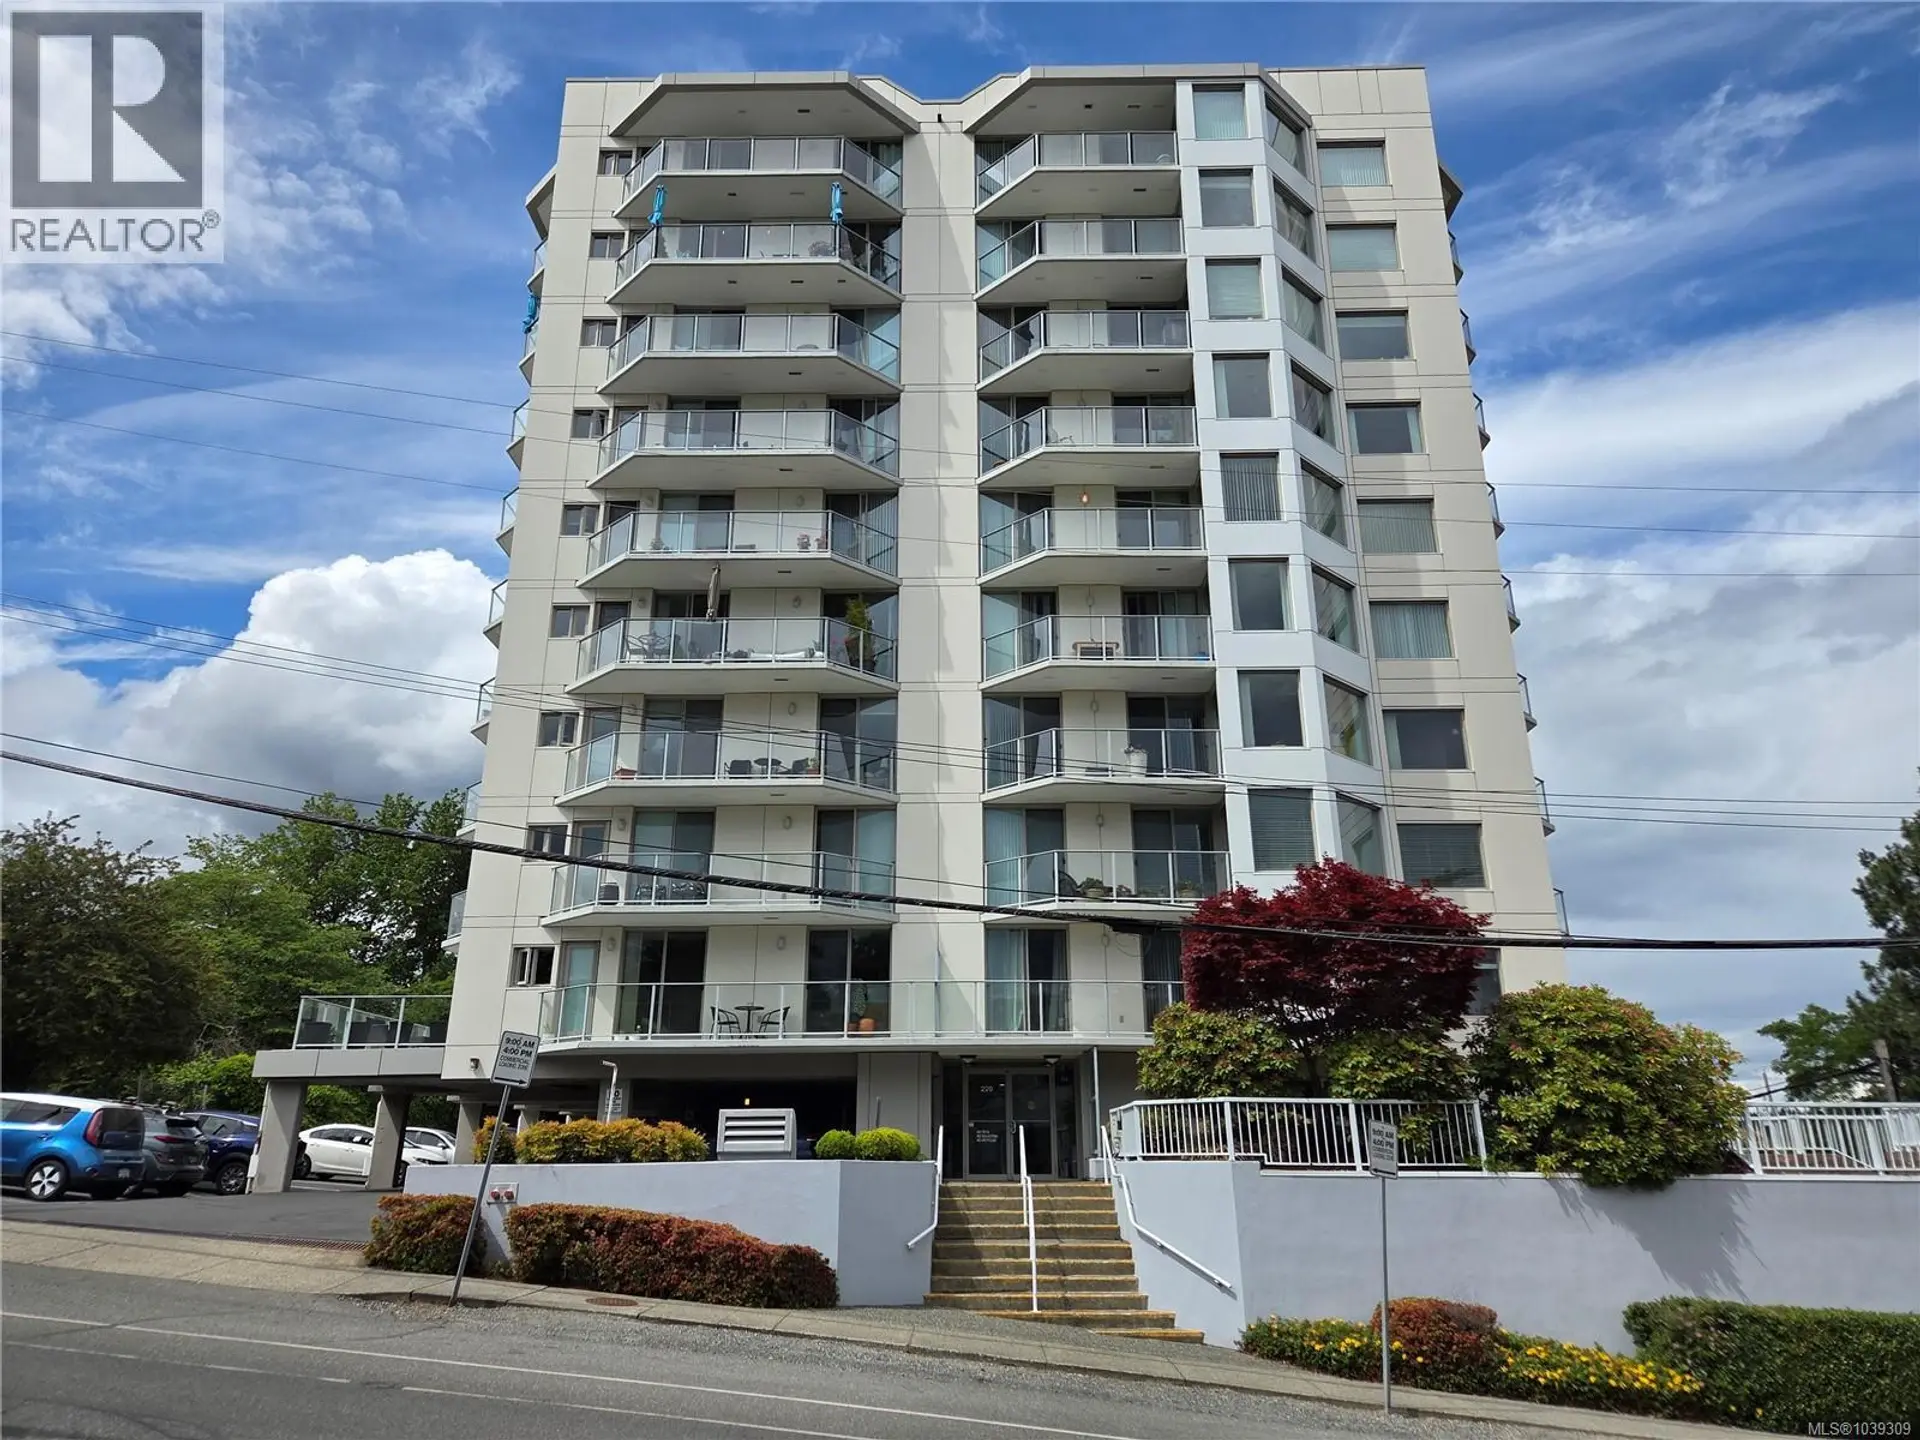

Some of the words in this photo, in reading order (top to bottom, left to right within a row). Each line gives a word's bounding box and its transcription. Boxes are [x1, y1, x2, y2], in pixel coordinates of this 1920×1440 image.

[522, 1040, 535, 1048] AM
[502, 1046, 519, 1055] 4:00
[520, 1049, 532, 1057] PM
